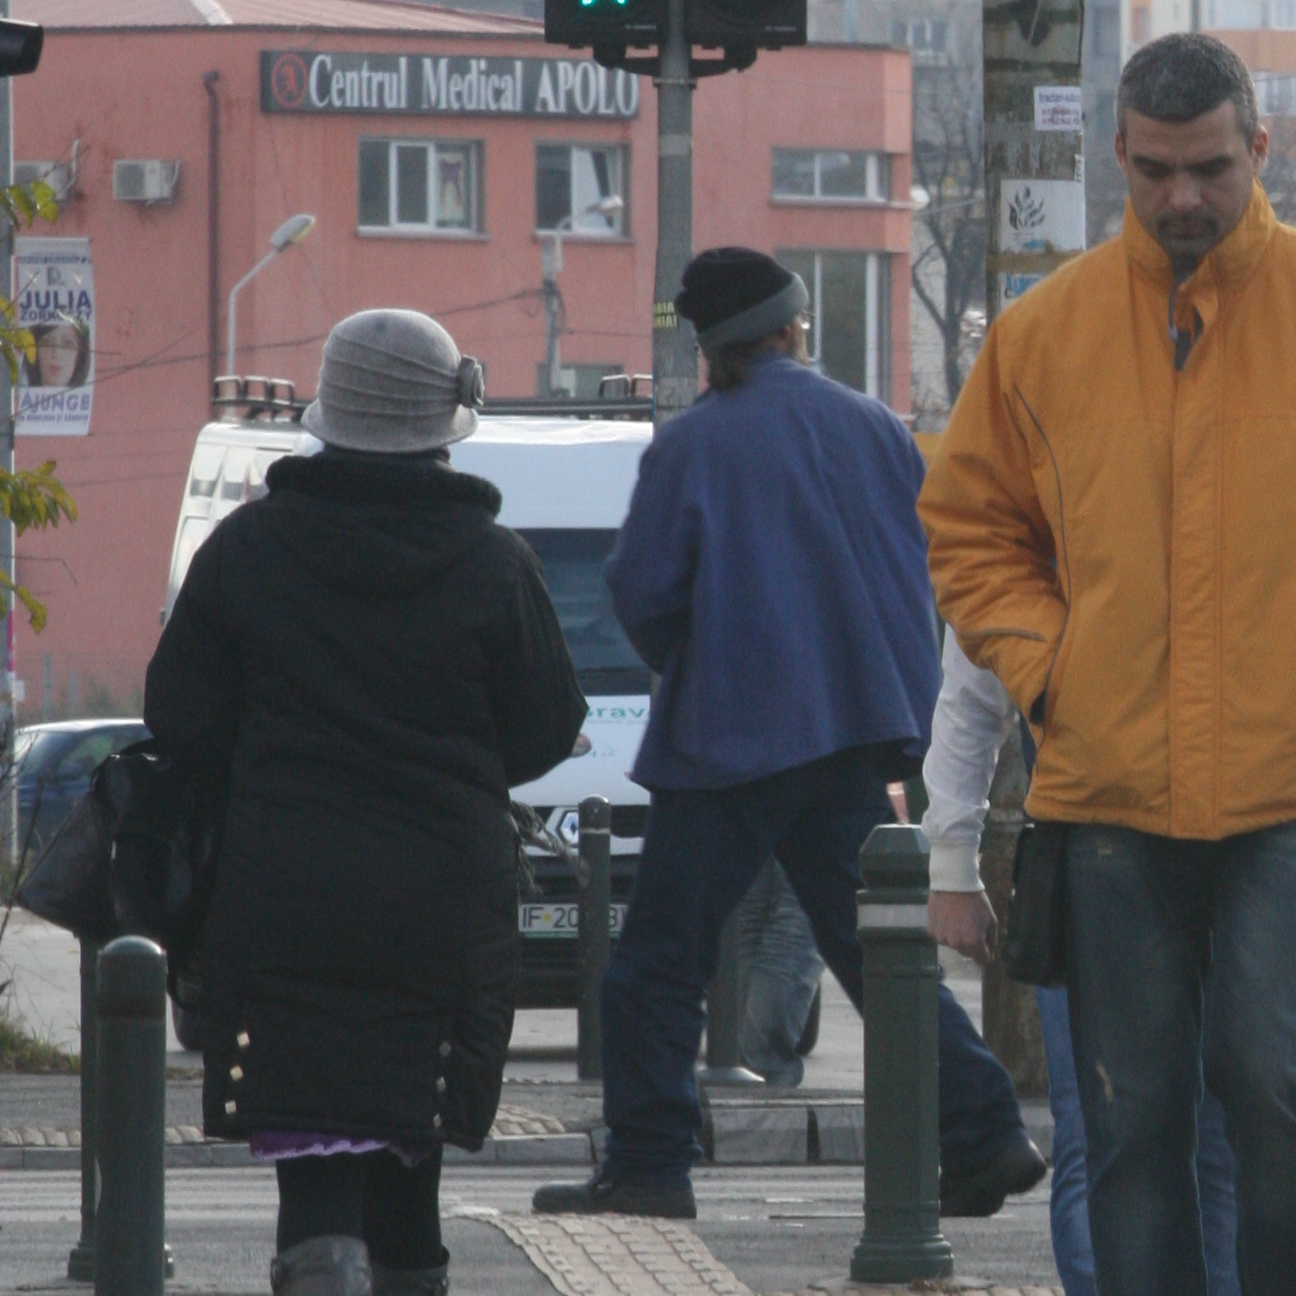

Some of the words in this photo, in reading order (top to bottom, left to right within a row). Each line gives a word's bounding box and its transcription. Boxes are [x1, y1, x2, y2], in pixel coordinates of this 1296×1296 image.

[309, 54, 409, 109] Centrul
[422, 57, 523, 112] Medical
[535, 59, 640, 116] APOLO
[19, 291, 92, 311] JULIA
[20, 391, 90, 415] AJUNGE
[588, 707, 646, 718] rav
[522, 907, 544, 928] IF
